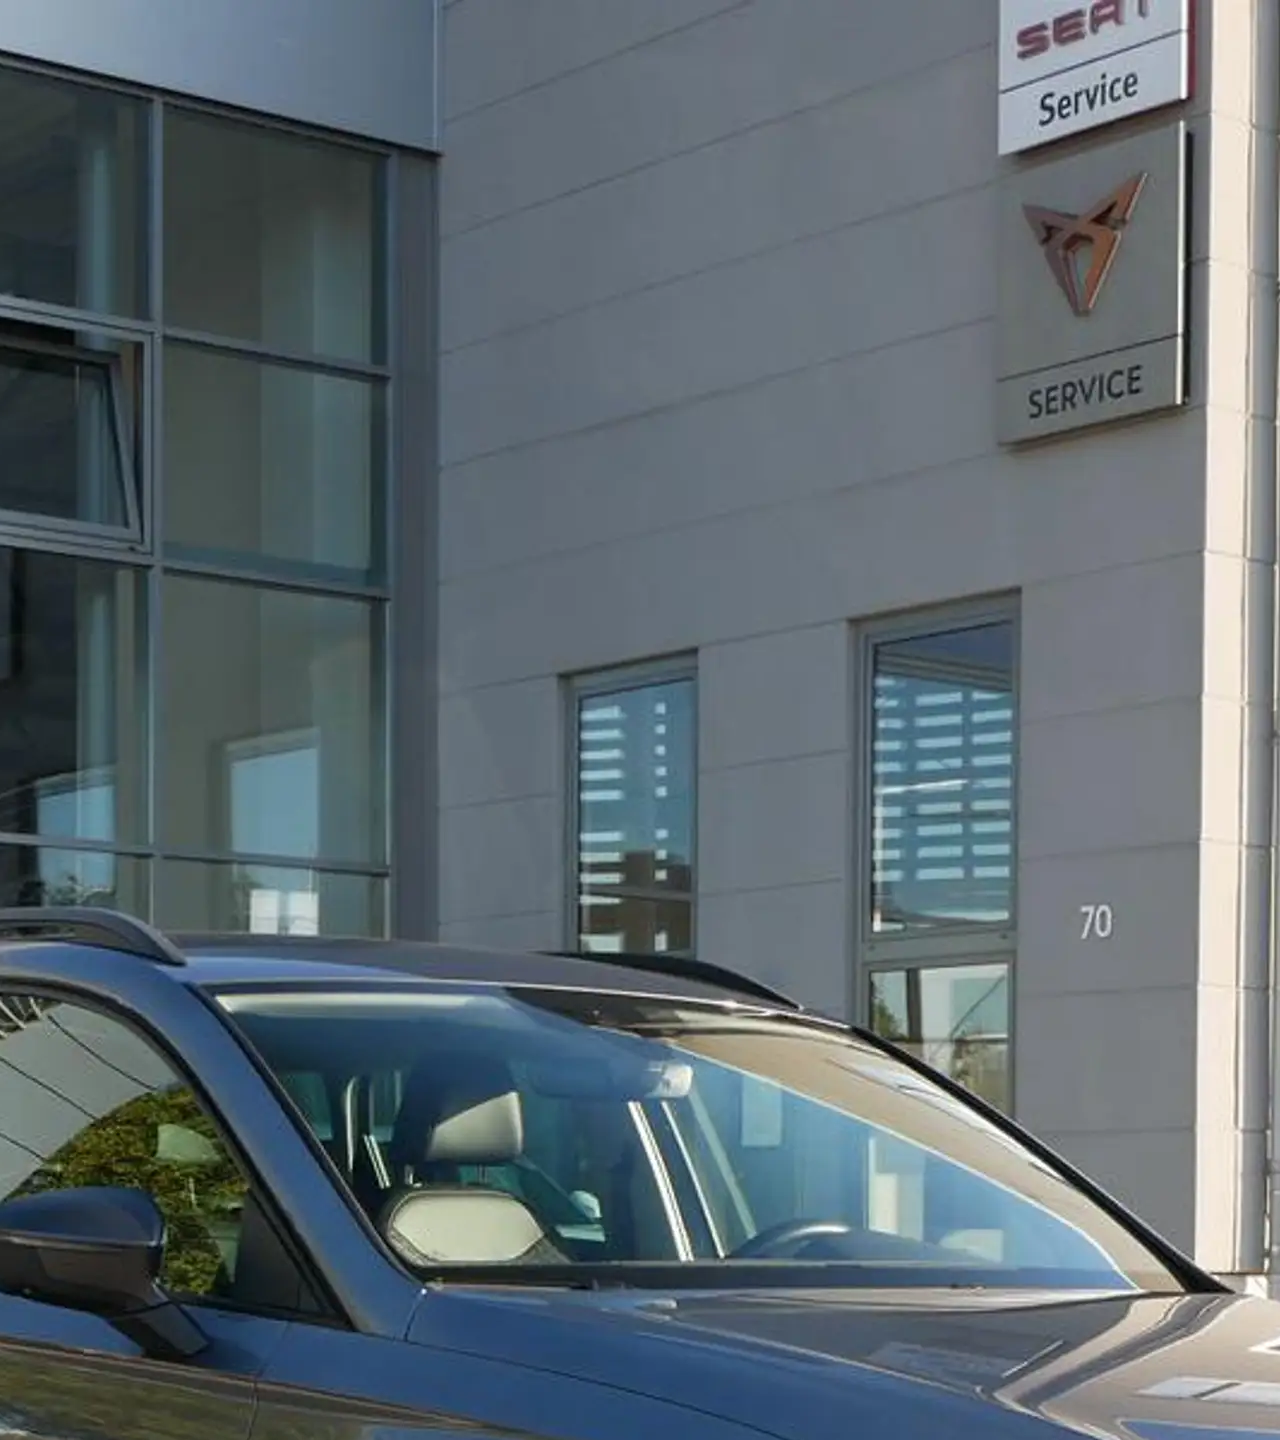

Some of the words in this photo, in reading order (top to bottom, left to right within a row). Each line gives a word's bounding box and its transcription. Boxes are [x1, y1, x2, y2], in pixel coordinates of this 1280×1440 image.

[1038, 72, 1139, 126] Service
[1028, 365, 1144, 420] SERVICE
[1080, 904, 1113, 939] 70
